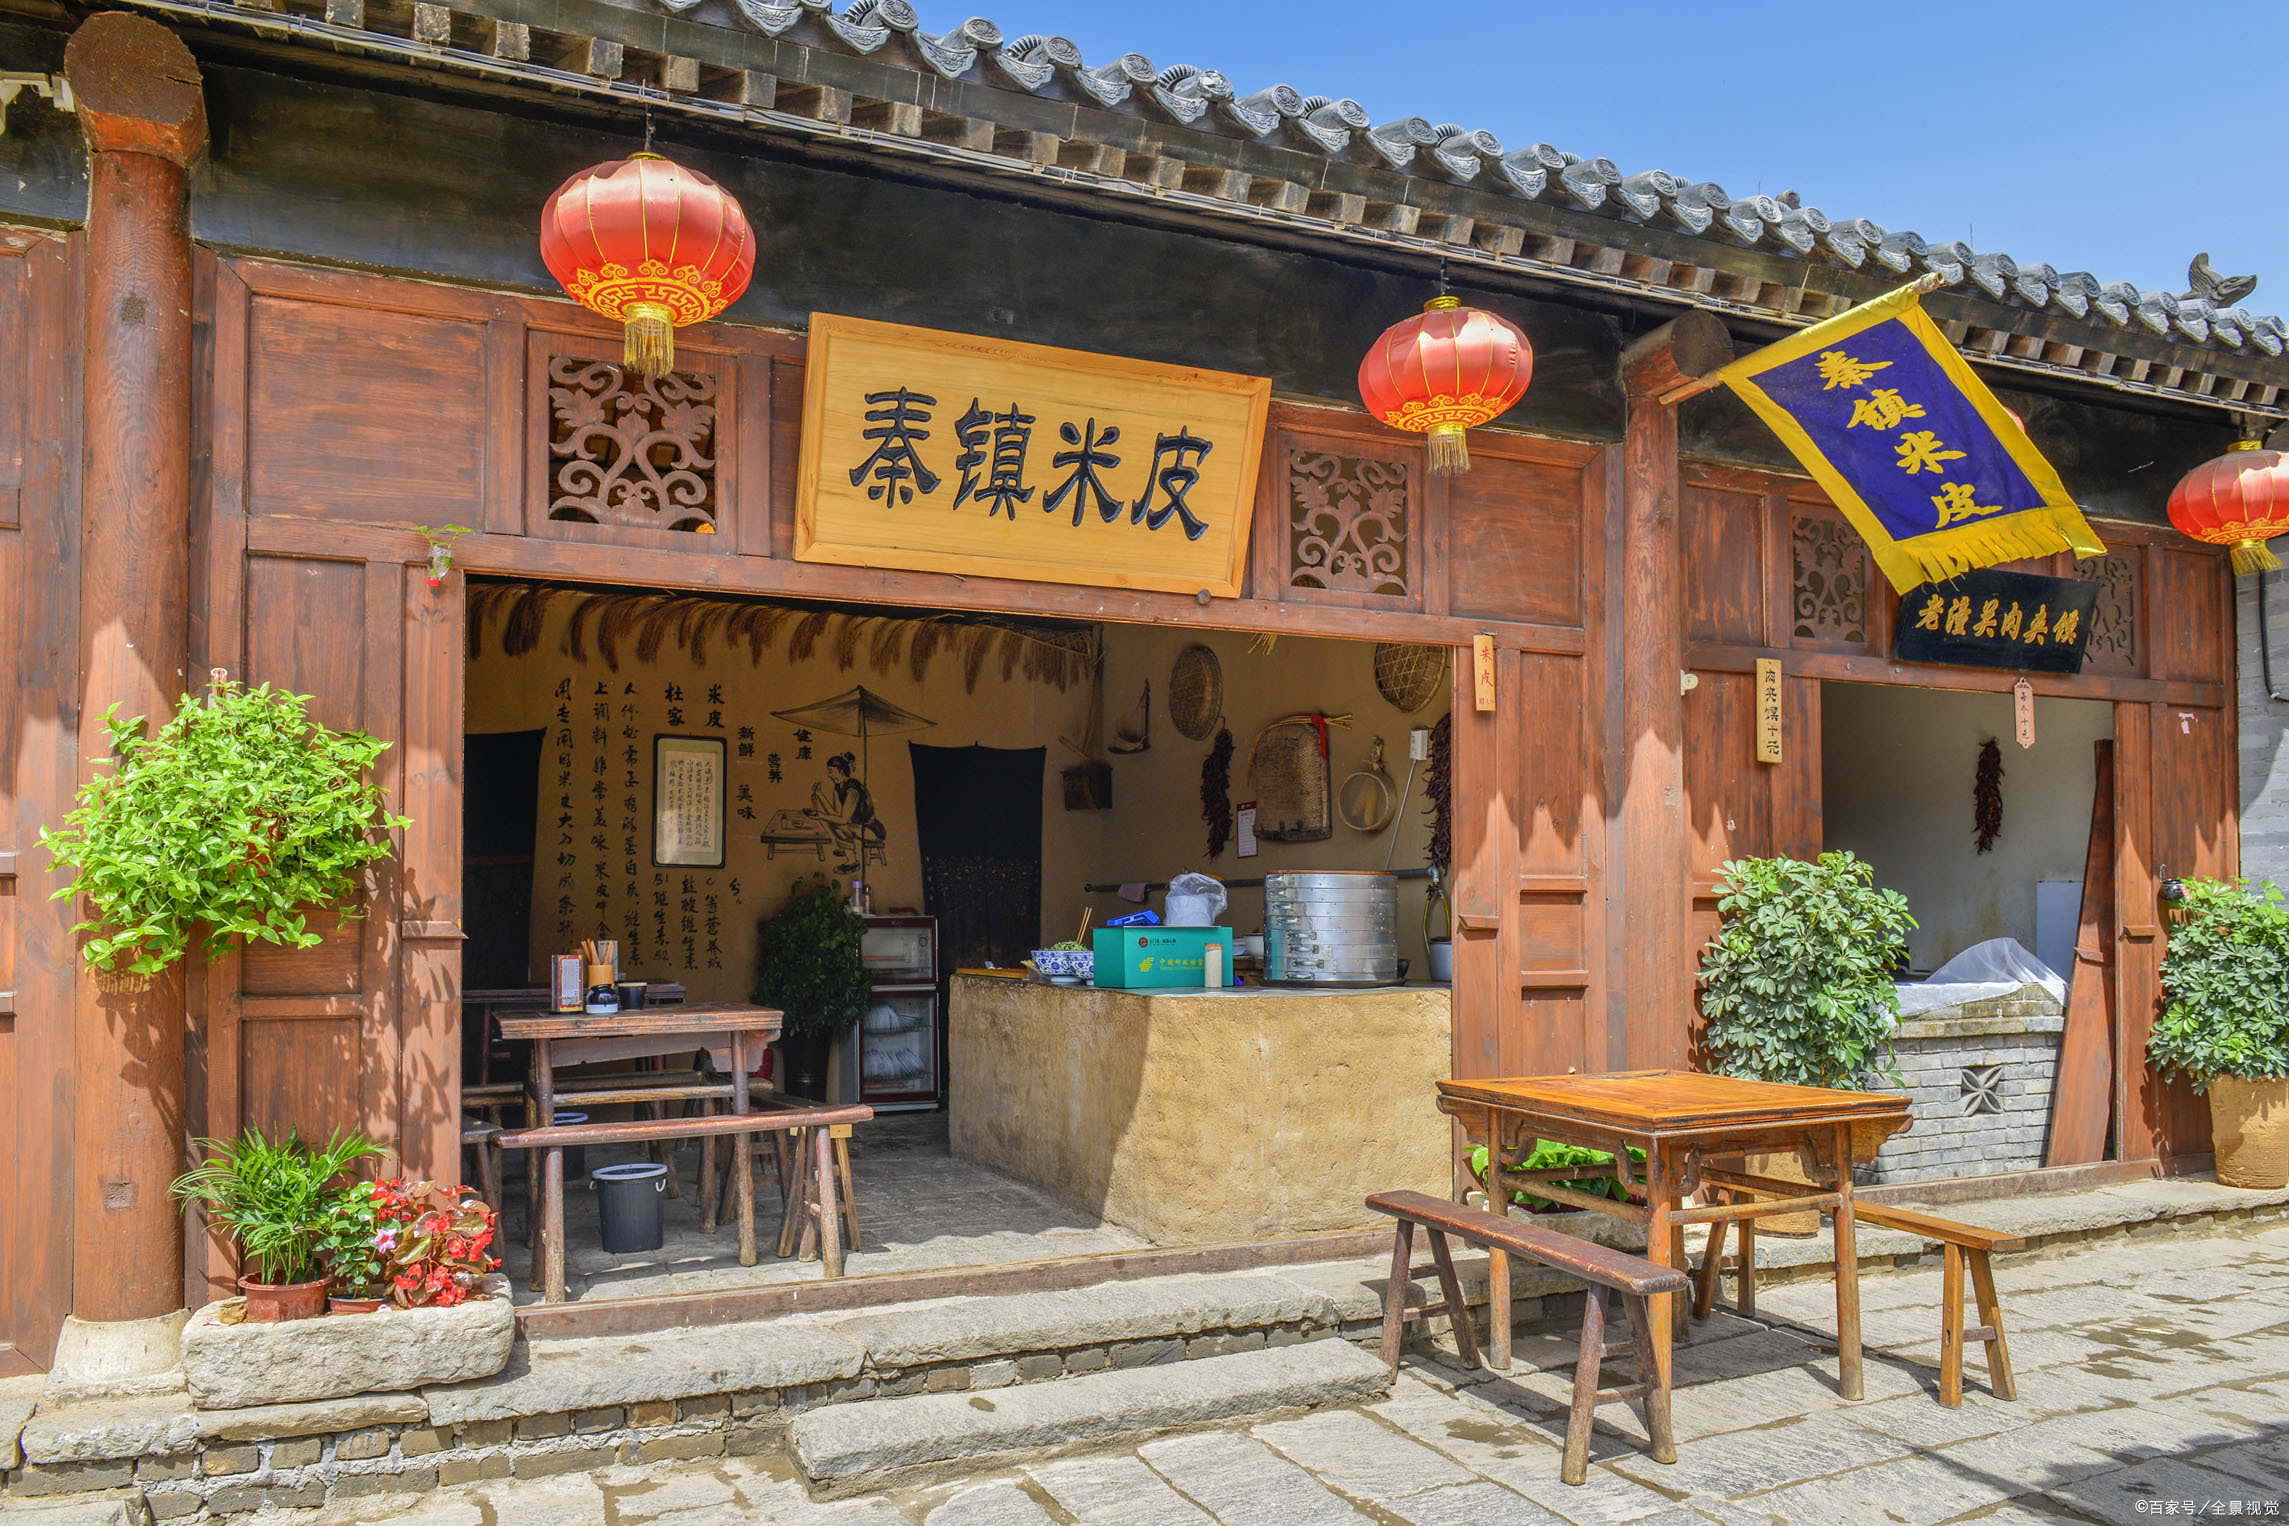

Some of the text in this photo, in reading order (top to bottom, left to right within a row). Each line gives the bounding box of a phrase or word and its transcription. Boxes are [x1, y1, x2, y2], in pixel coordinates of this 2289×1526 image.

[1814, 350, 2003, 528] 秦镇米皮
[849, 386, 1213, 541] 秦镇米皮
[664, 681, 686, 727] 杜家
[705, 683, 726, 729] 米皮
[1764, 668, 1779, 755] 肉夹馍十元
[738, 726, 755, 758] 新鲜
[793, 728, 813, 760] 健康
[767, 753, 783, 784] 营养
[736, 784, 756, 819] 美味
